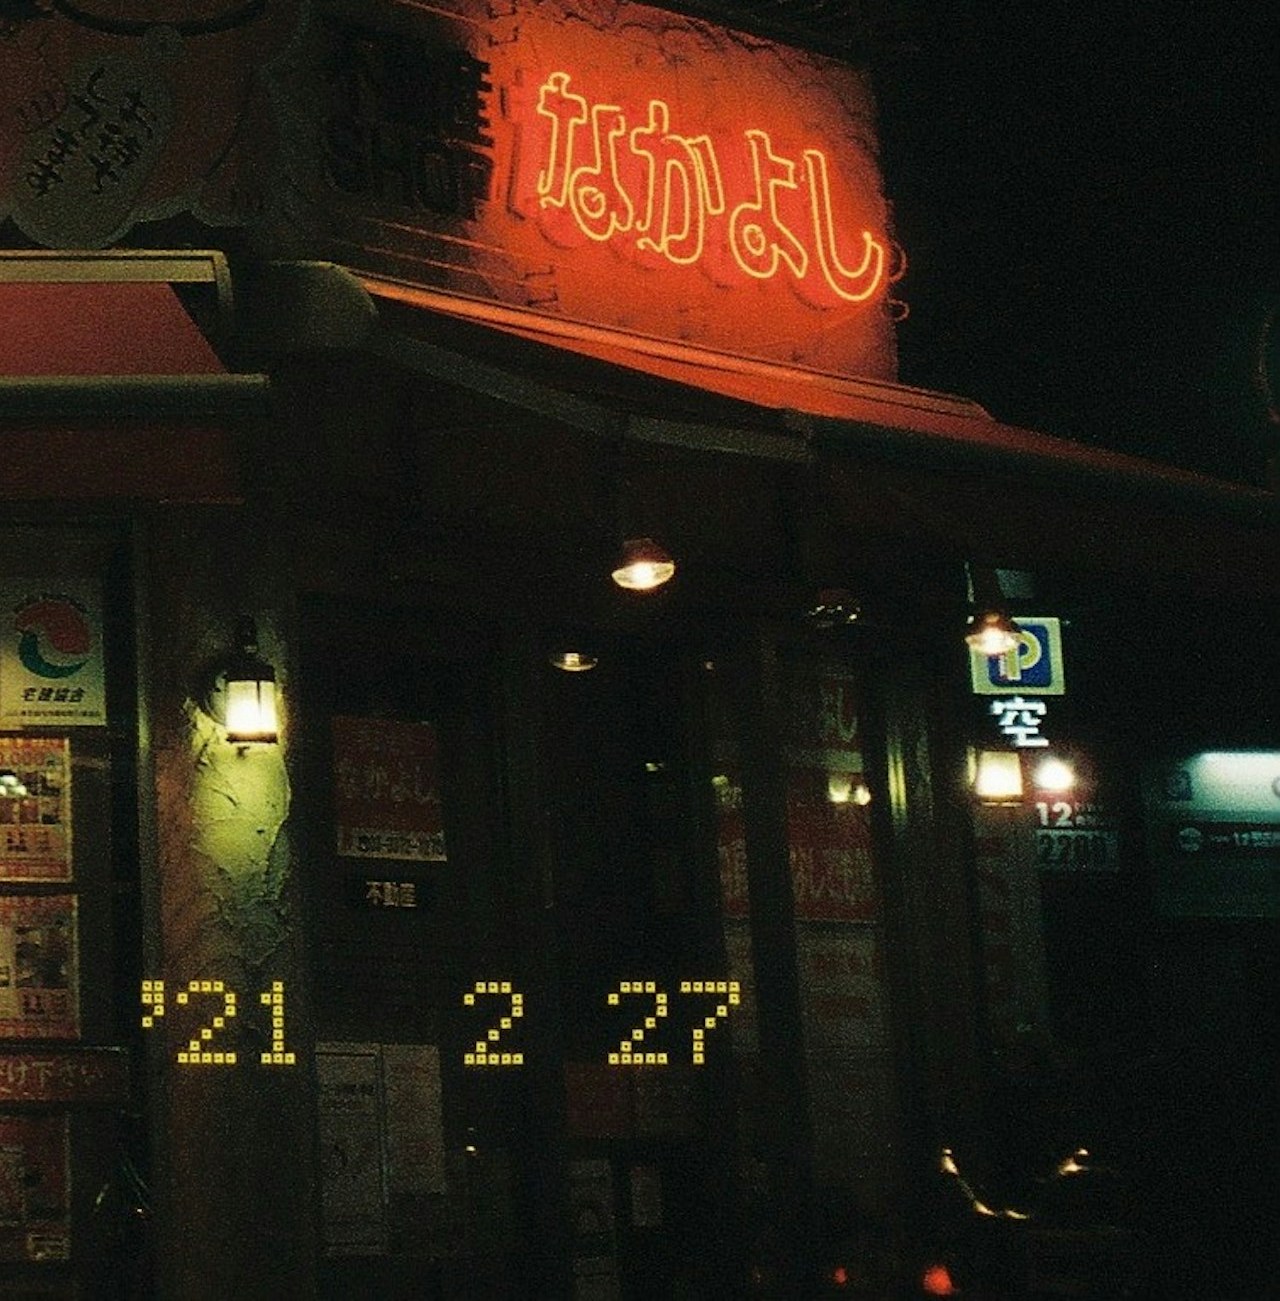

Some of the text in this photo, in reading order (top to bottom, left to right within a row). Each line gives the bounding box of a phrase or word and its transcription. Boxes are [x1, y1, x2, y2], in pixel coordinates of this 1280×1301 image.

[536, 71, 884, 302] なかよし
[991, 696, 1049, 747] 空
